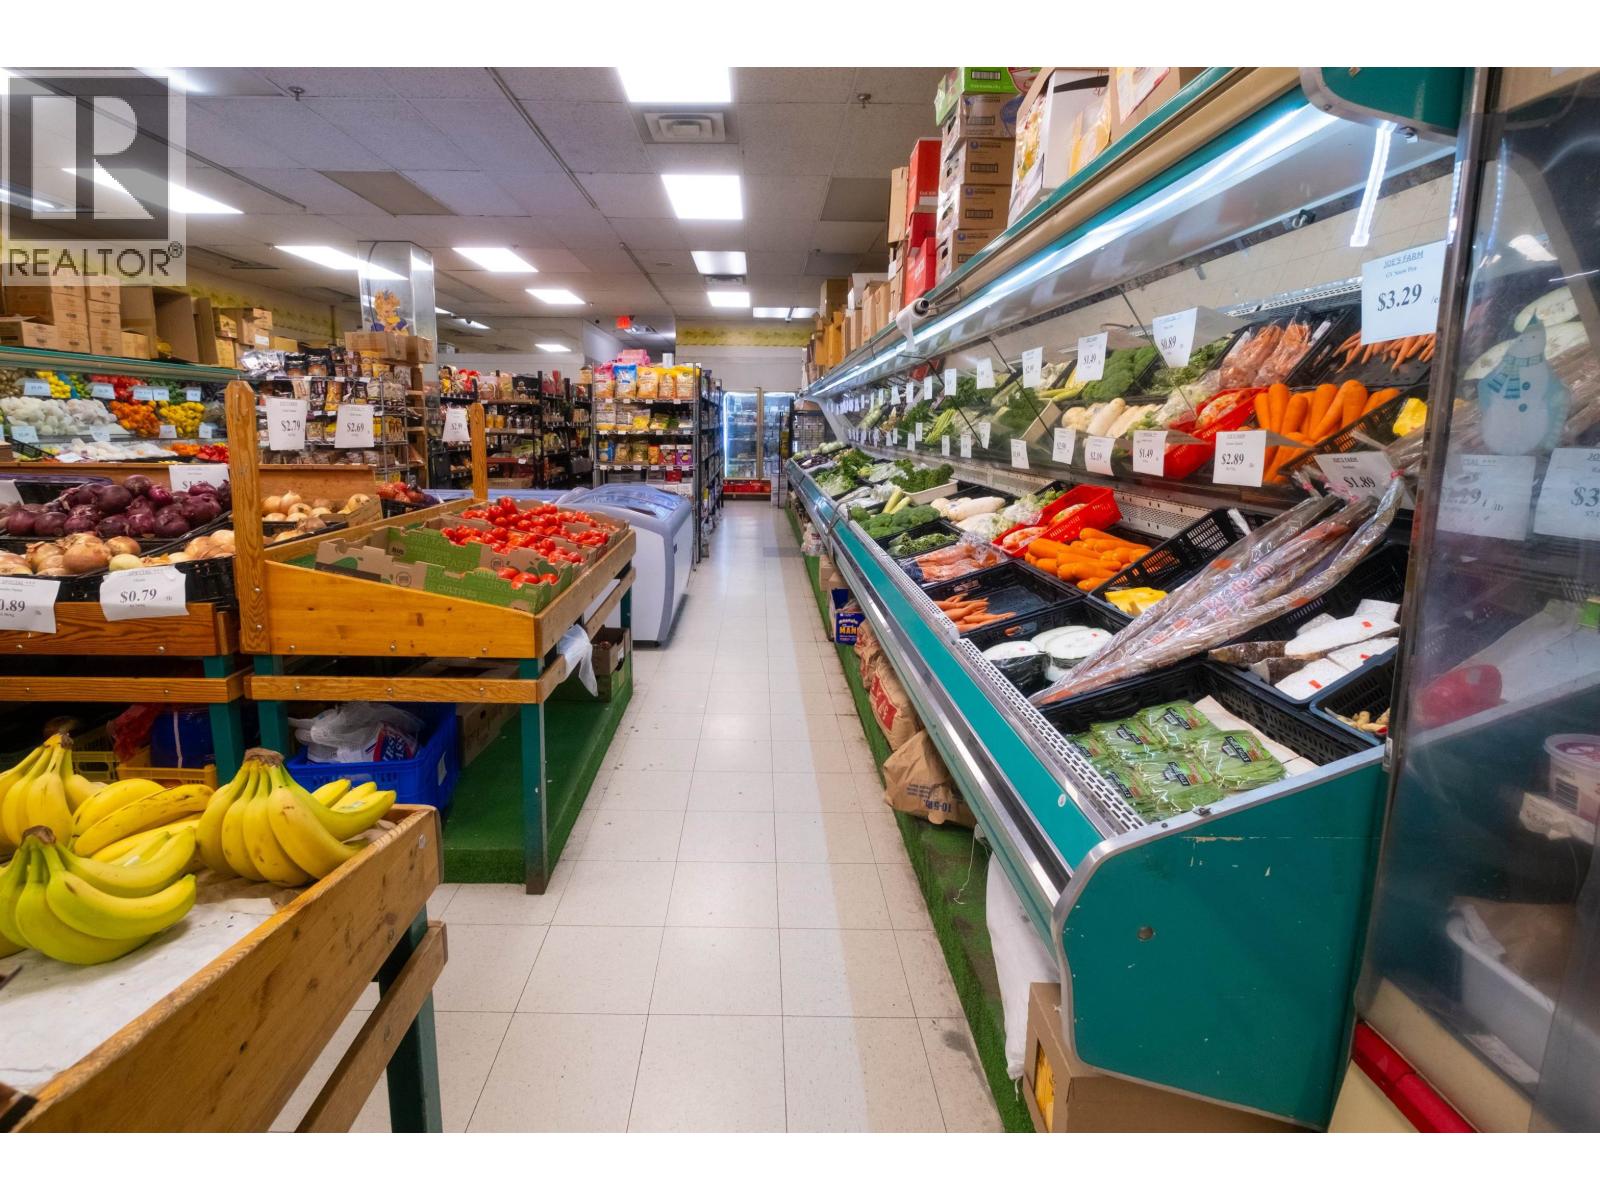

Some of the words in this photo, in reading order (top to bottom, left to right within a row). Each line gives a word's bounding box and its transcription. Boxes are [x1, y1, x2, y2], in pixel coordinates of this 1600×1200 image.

[1377, 283, 1422, 312] $3.29
[280, 419, 301, 433] $2.79
[346, 422, 365, 433] $2.69
[1221, 453, 1245, 466] $2.89
[1343, 475, 1376, 488] $1.89
[1570, 486, 1600, 507] $3
[120, 588, 157, 604] $0.79
[0, 599, 26, 612] 0.89
